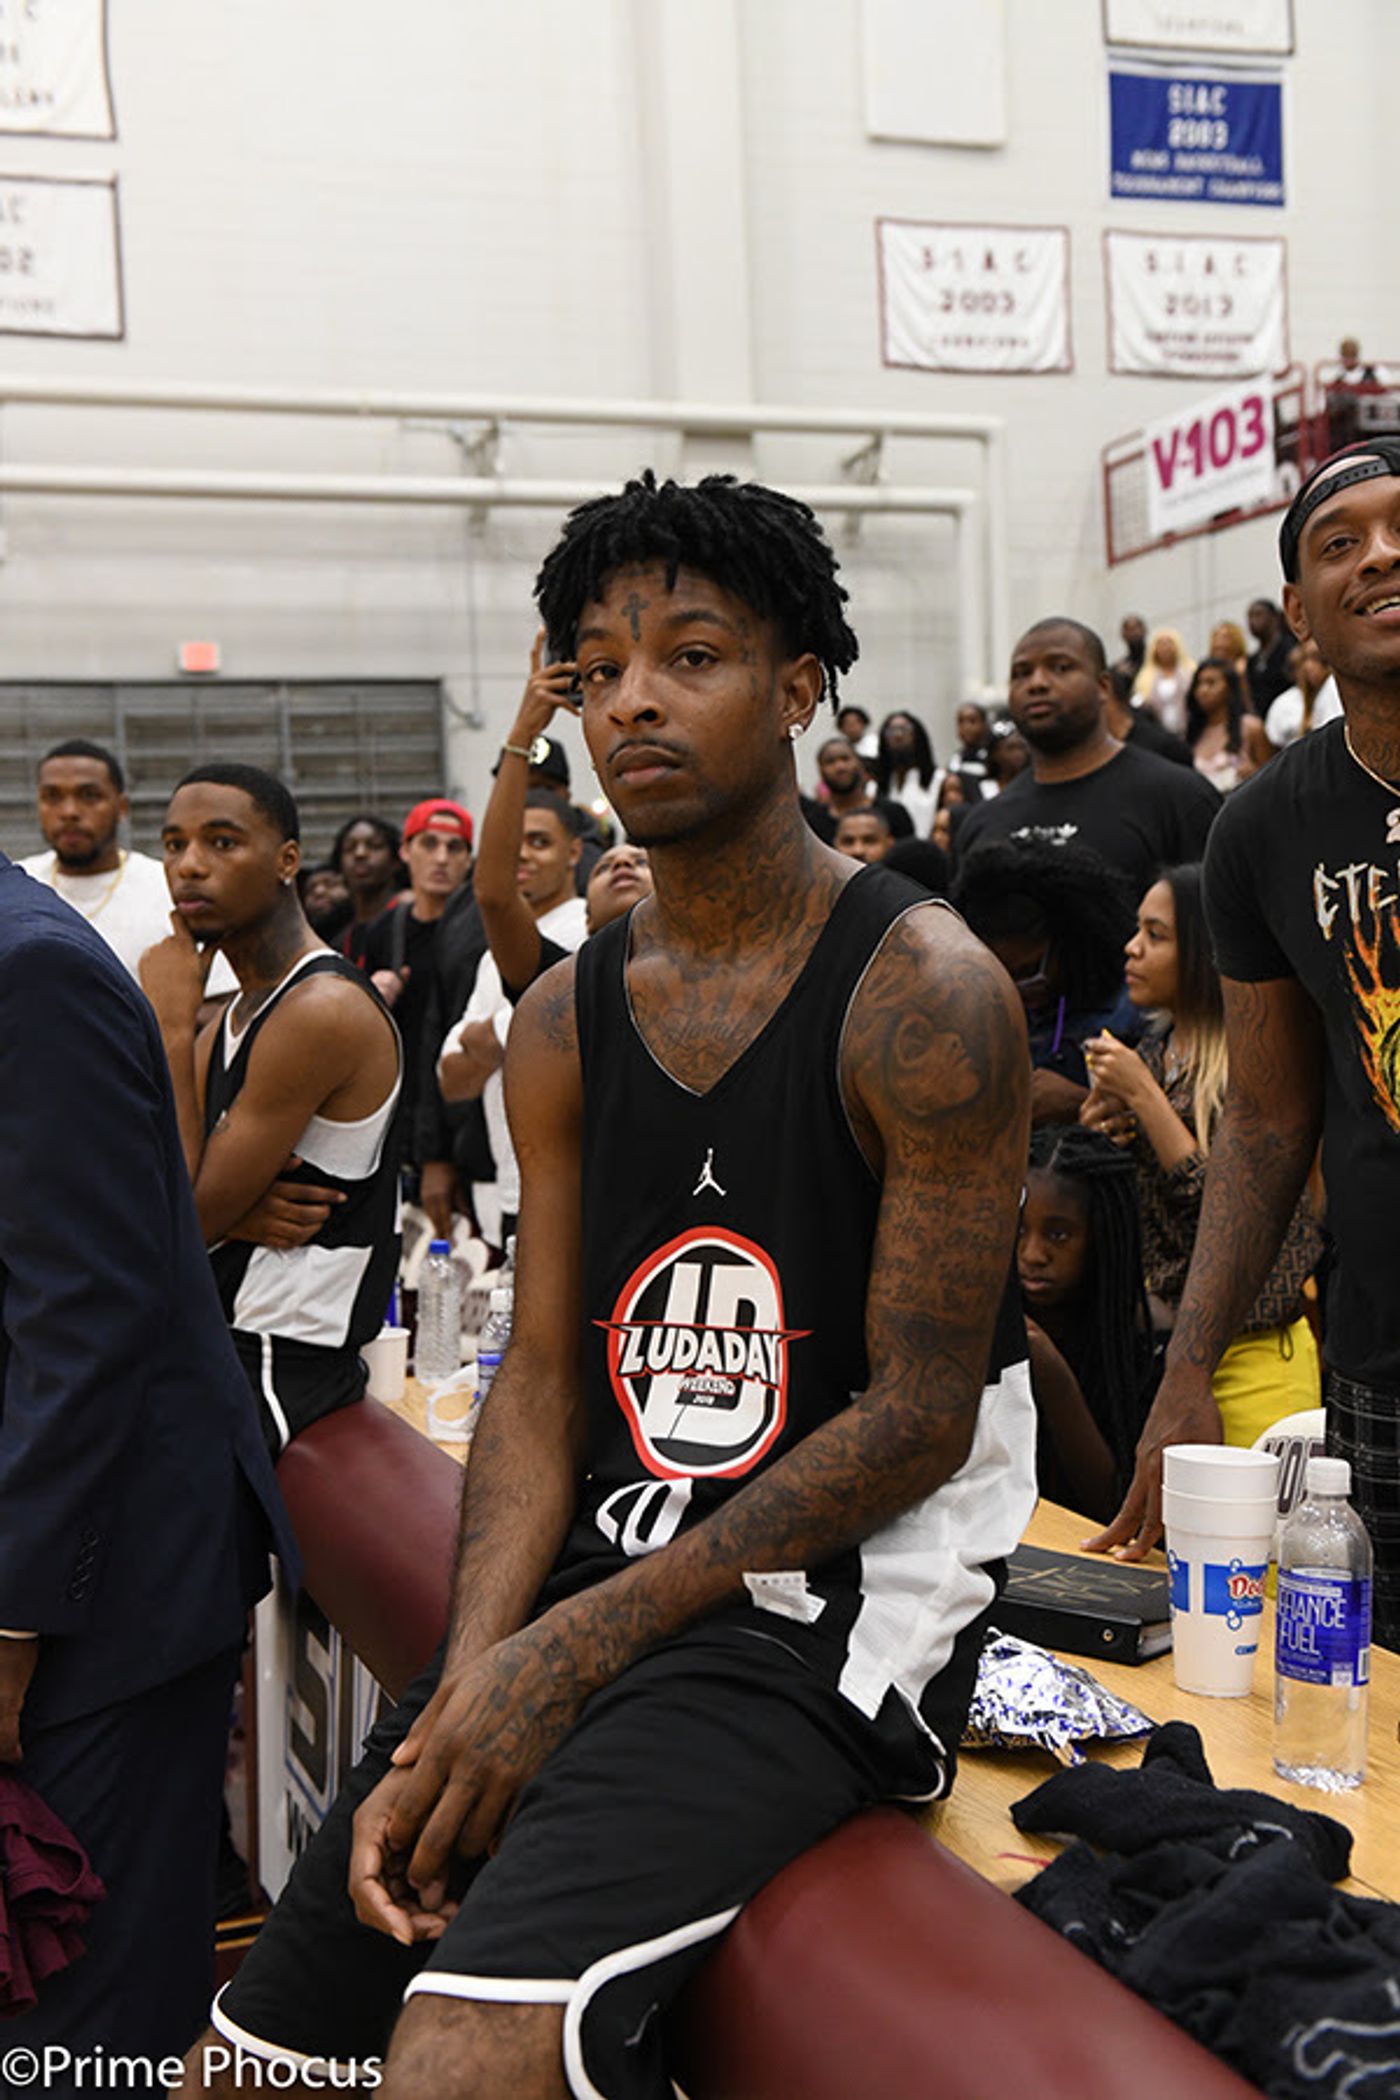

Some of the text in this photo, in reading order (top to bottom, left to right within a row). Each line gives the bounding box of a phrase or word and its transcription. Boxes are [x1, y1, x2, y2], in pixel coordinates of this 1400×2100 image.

[1167, 82, 1228, 117] SIAC
[1152, 395, 1266, 490] V-103
[1313, 862, 1400, 940] ETE
